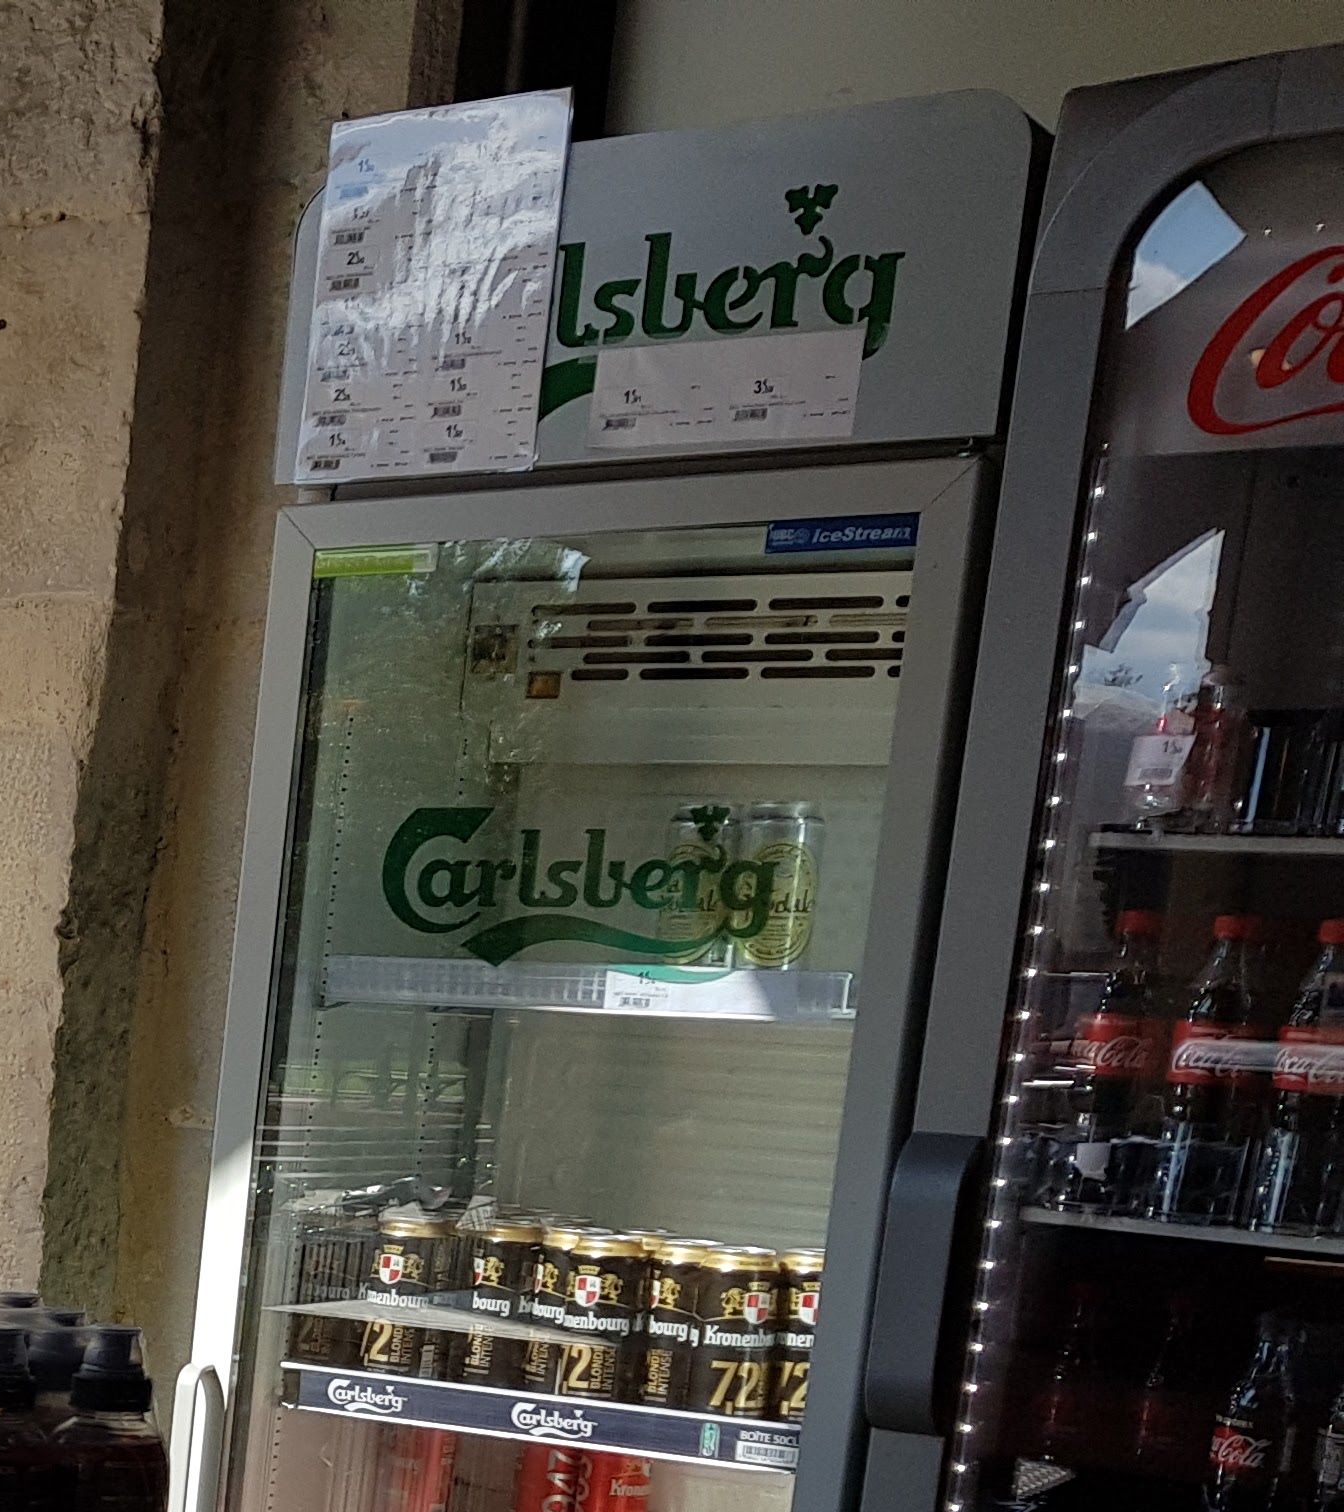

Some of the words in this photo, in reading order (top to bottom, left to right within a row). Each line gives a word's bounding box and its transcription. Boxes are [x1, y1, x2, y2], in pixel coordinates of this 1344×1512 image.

[556, 231, 906, 361] lsberg
[813, 527, 912, 543] IceStream
[383, 807, 780, 938] Carlsberg
[390, 1324, 403, 1363] BLOND
[327, 1378, 406, 1412] Carlsberg
[511, 1402, 596, 1438] Carlsberg
